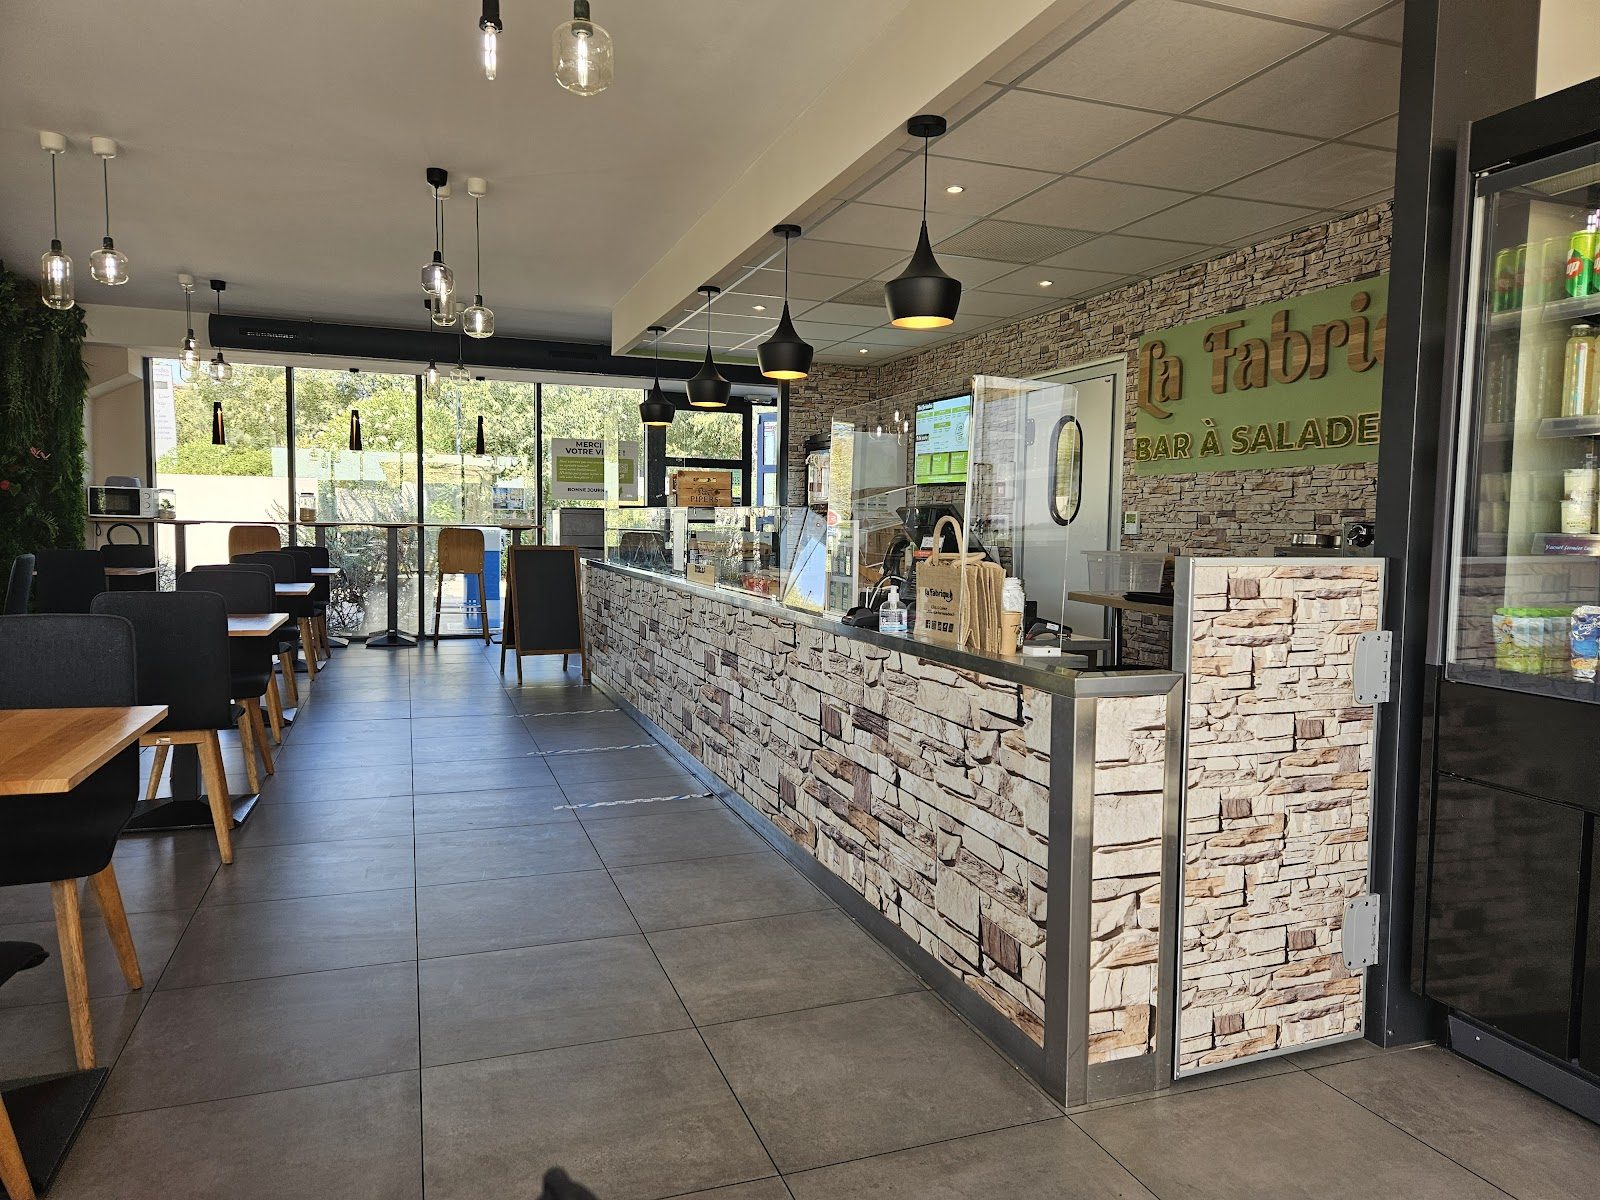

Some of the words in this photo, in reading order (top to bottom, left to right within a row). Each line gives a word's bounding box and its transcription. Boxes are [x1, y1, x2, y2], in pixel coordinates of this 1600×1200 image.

[1137, 340, 1183, 419] La
[575, 441, 602, 449] MERCI
[1135, 432, 1191, 462] BAR
[1199, 418, 1222, 457] À
[690, 495, 719, 503] PIPERS
